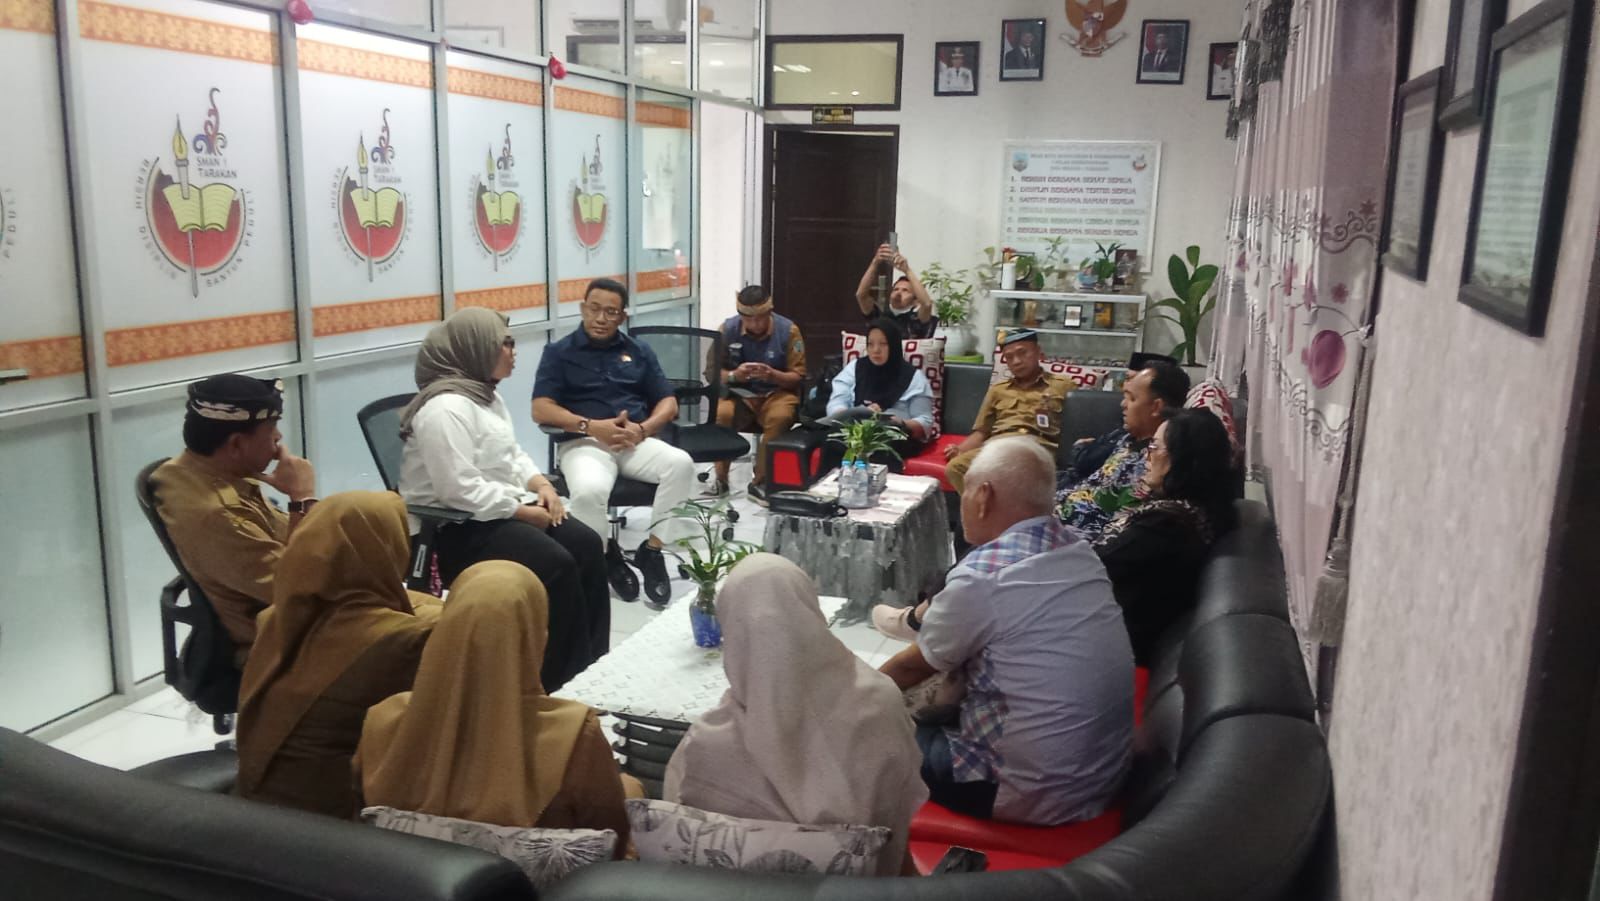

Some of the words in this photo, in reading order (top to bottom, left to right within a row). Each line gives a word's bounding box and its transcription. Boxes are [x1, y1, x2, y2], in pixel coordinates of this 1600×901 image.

[196, 157, 220, 166] SMAN
[197, 168, 237, 178] TARAKAN
[1048, 175, 1080, 183] BERSAMA
